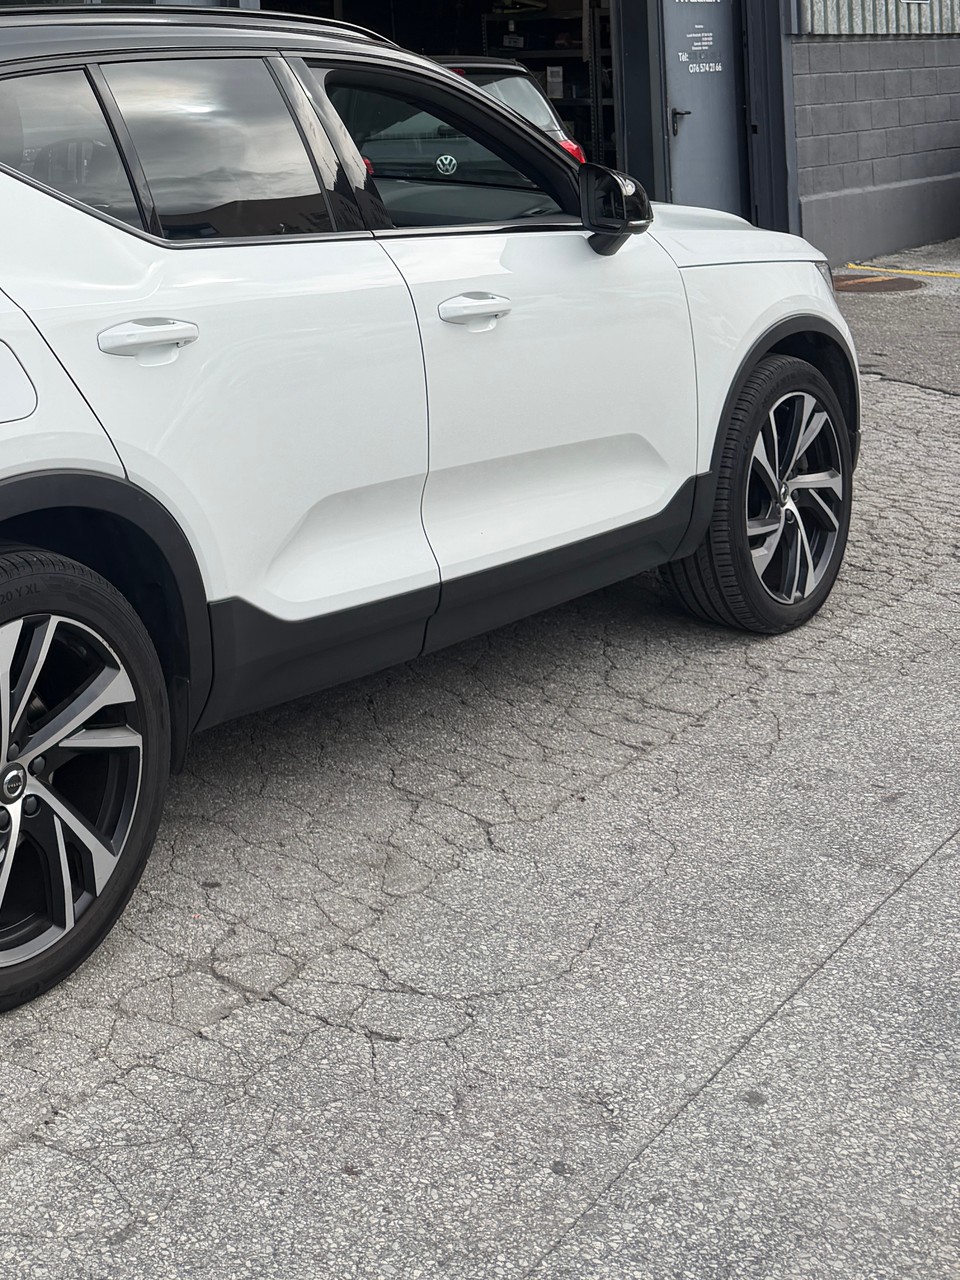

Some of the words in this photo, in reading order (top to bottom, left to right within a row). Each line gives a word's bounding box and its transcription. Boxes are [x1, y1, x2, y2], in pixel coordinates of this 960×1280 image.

[688, 63, 700, 73] 076
[0, 591, 13, 604] 20
[15, 586, 23, 598] Y
[25, 583, 41, 595] XL
